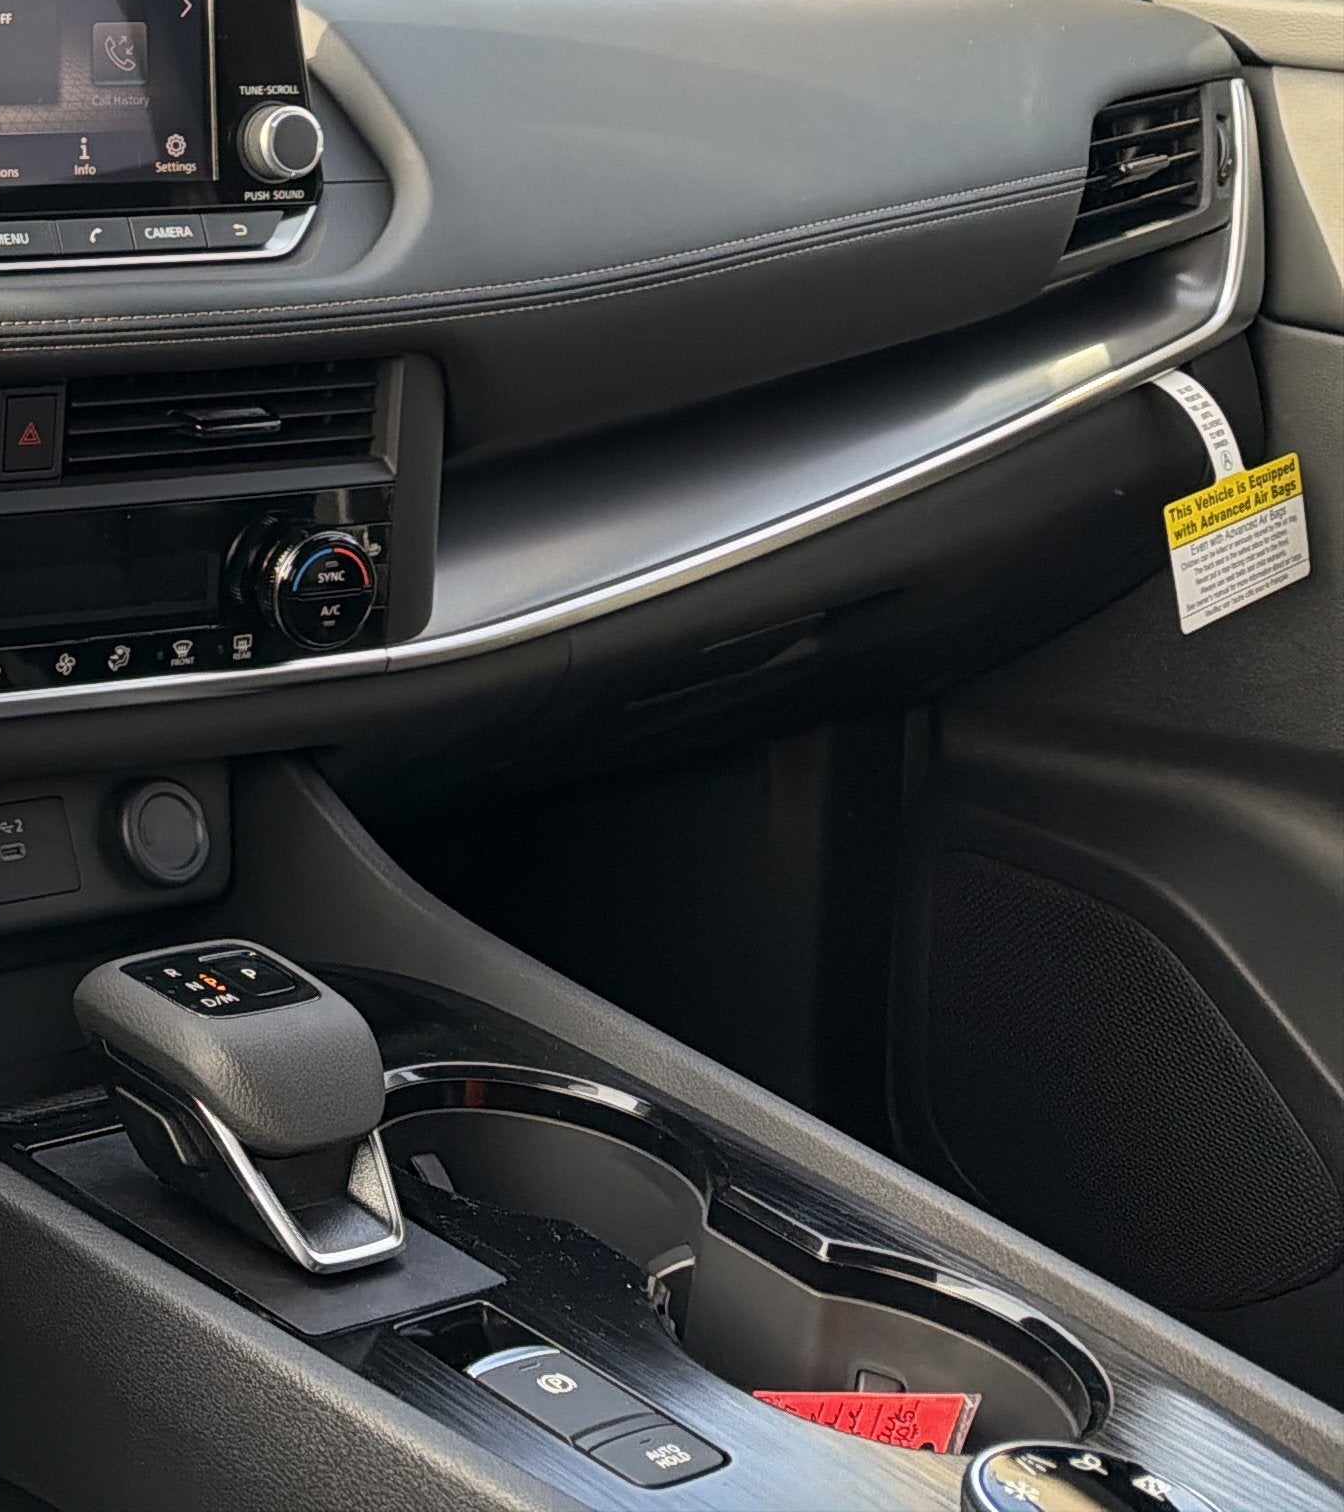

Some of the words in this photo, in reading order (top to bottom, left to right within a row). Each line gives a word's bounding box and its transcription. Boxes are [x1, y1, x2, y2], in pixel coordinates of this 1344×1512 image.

[92, 95, 111, 107] Call
[112, 94, 150, 109] History
[73, 164, 97, 176] Info
[155, 161, 197, 176] Settings
[244, 190, 270, 201] PUSH
[273, 189, 305, 200] SOUND
[144, 226, 194, 240] CAMERA
[1168, 503, 1193, 523] This
[1194, 486, 1235, 512] Vehicle
[1236, 481, 1247, 495] is
[1248, 458, 1296, 490] Equipped
[1173, 522, 1198, 541] with
[1200, 496, 1251, 531] Advanced
[1254, 490, 1269, 507] Air
[1270, 479, 1296, 499] Bags
[1190, 540, 1209, 556] Even
[1225, 518, 1259, 540] Advanced
[317, 569, 346, 584] SYNC
[320, 604, 341, 617] A/C
[170, 656, 195, 666] FRONT
[232, 650, 253, 660] REAR
[13, 819, 24, 834] 2
[200, 993, 241, 1008] D/M
[645, 1443, 681, 1462] AUTO
[655, 1452, 691, 1470] HOLD
